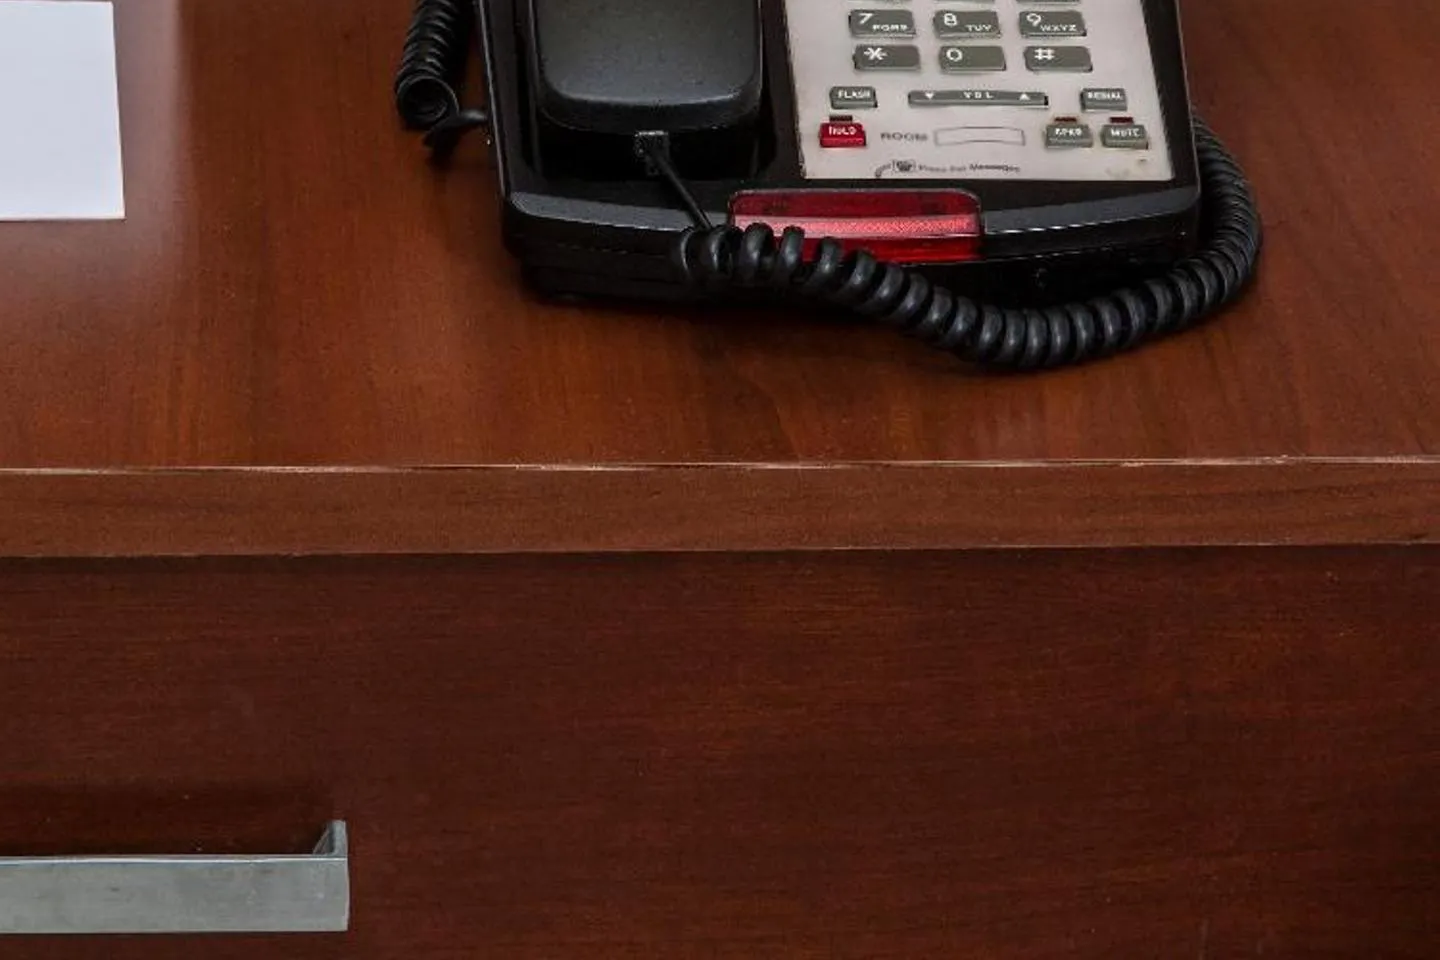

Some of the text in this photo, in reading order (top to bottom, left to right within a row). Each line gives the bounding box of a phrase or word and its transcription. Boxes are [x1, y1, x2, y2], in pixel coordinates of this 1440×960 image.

[858, 12, 873, 24] 7
[943, 13, 958, 26] 8
[1026, 13, 1077, 32] 9 WXYZ
[946, 47, 962, 61] 0
[1033, 48, 1055, 60] #
[837, 90, 871, 99] FLASH
[963, 91, 994, 99] VOL
[828, 125, 858, 136] HOLD
[1110, 127, 1140, 137] MUTE
